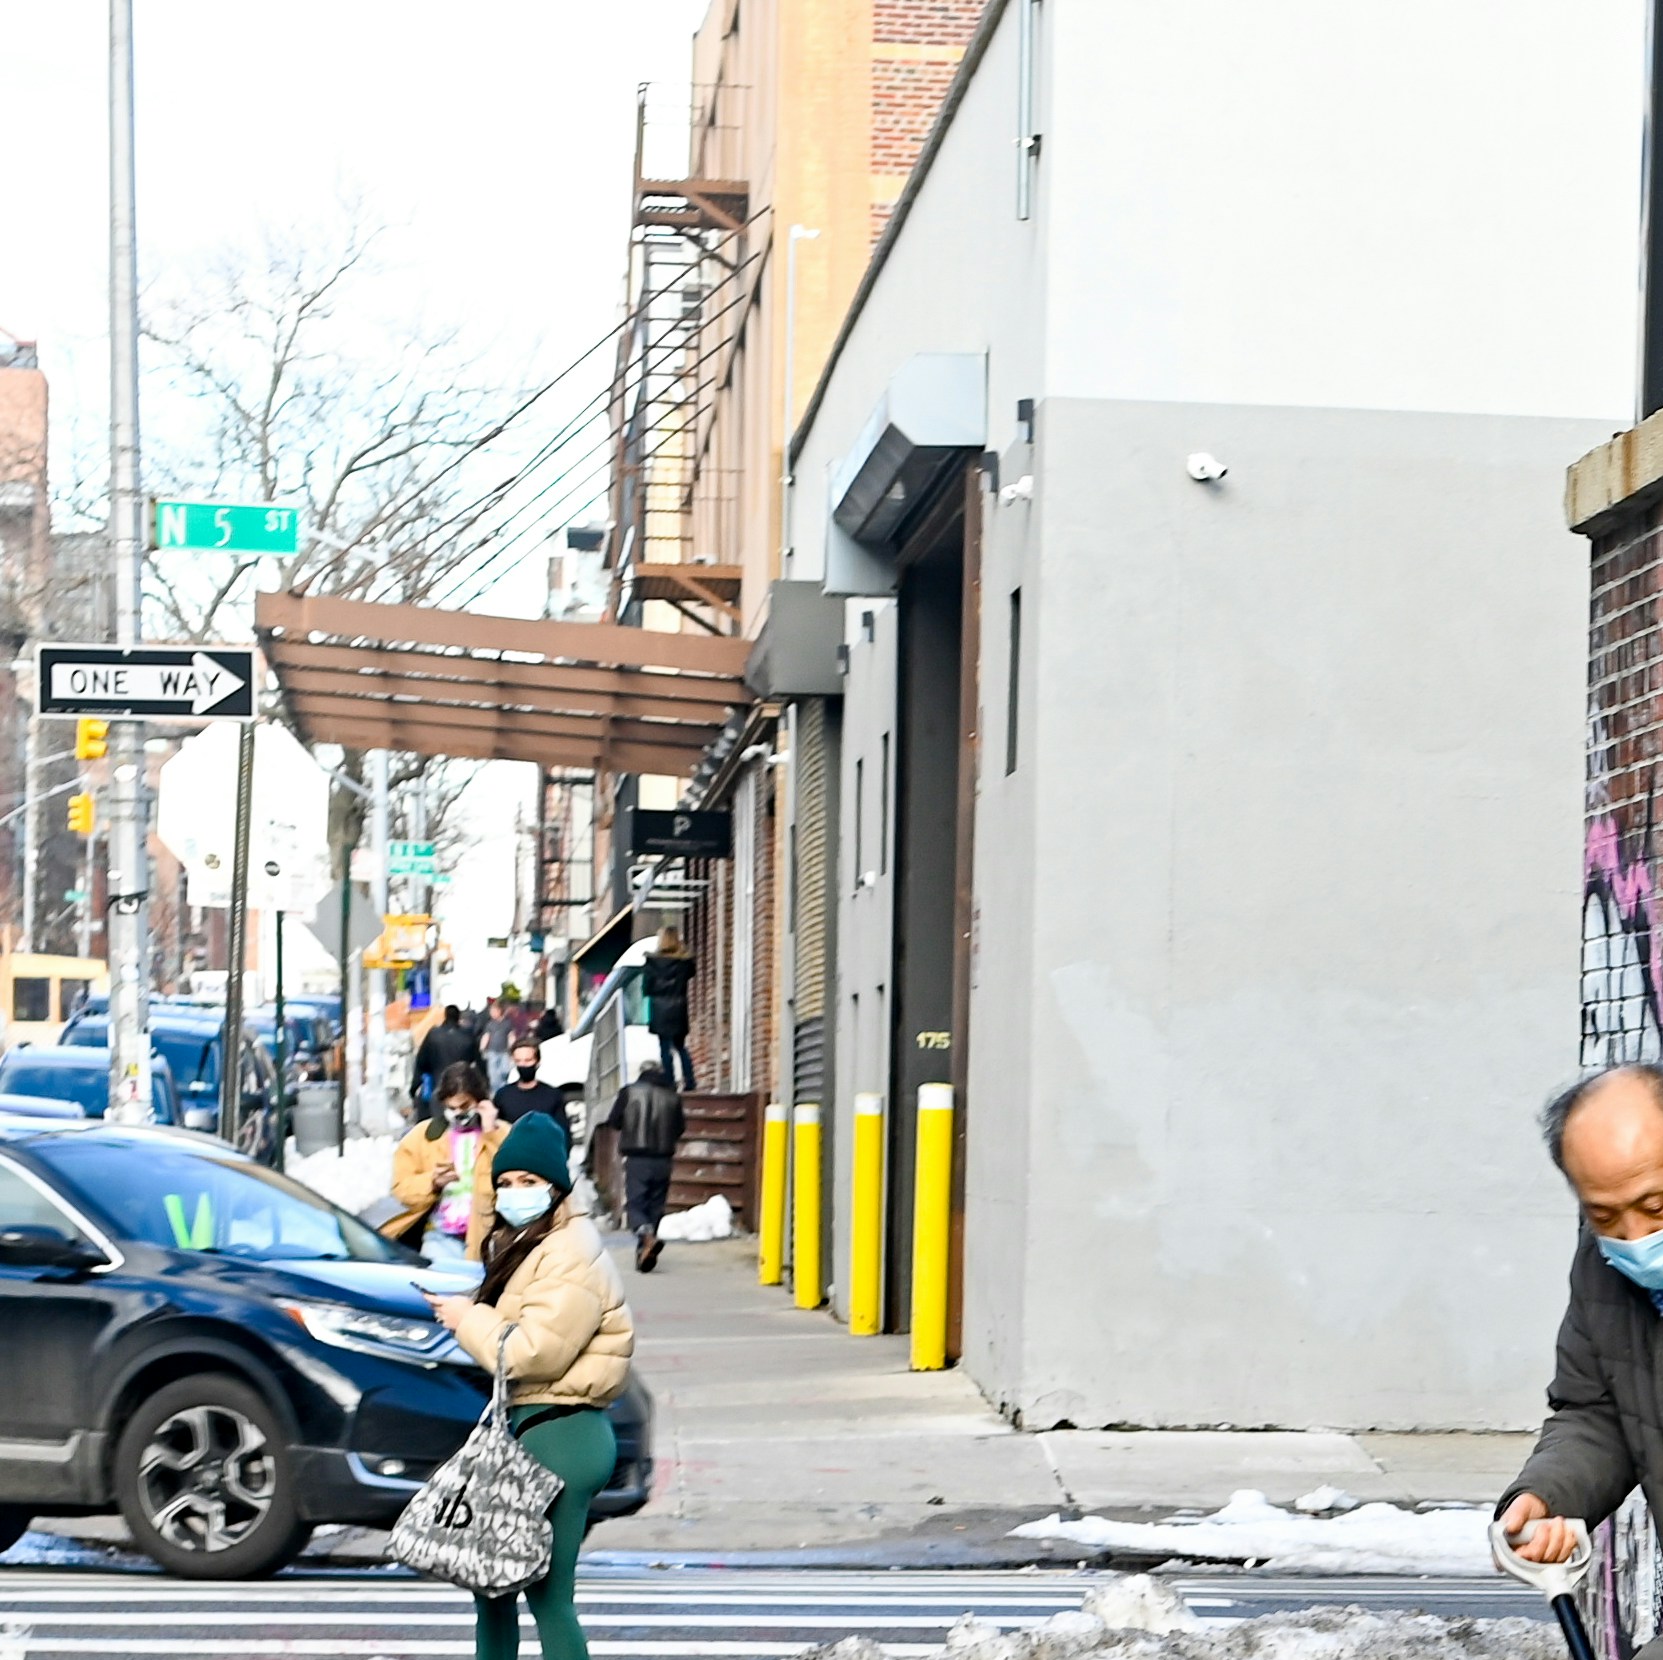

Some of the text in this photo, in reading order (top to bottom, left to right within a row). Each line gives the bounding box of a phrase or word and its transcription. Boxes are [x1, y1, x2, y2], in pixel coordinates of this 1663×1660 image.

[161, 505, 290, 547] N 5 ST
[70, 669, 221, 696] ONE WAY
[916, 1031, 951, 1049] 175
